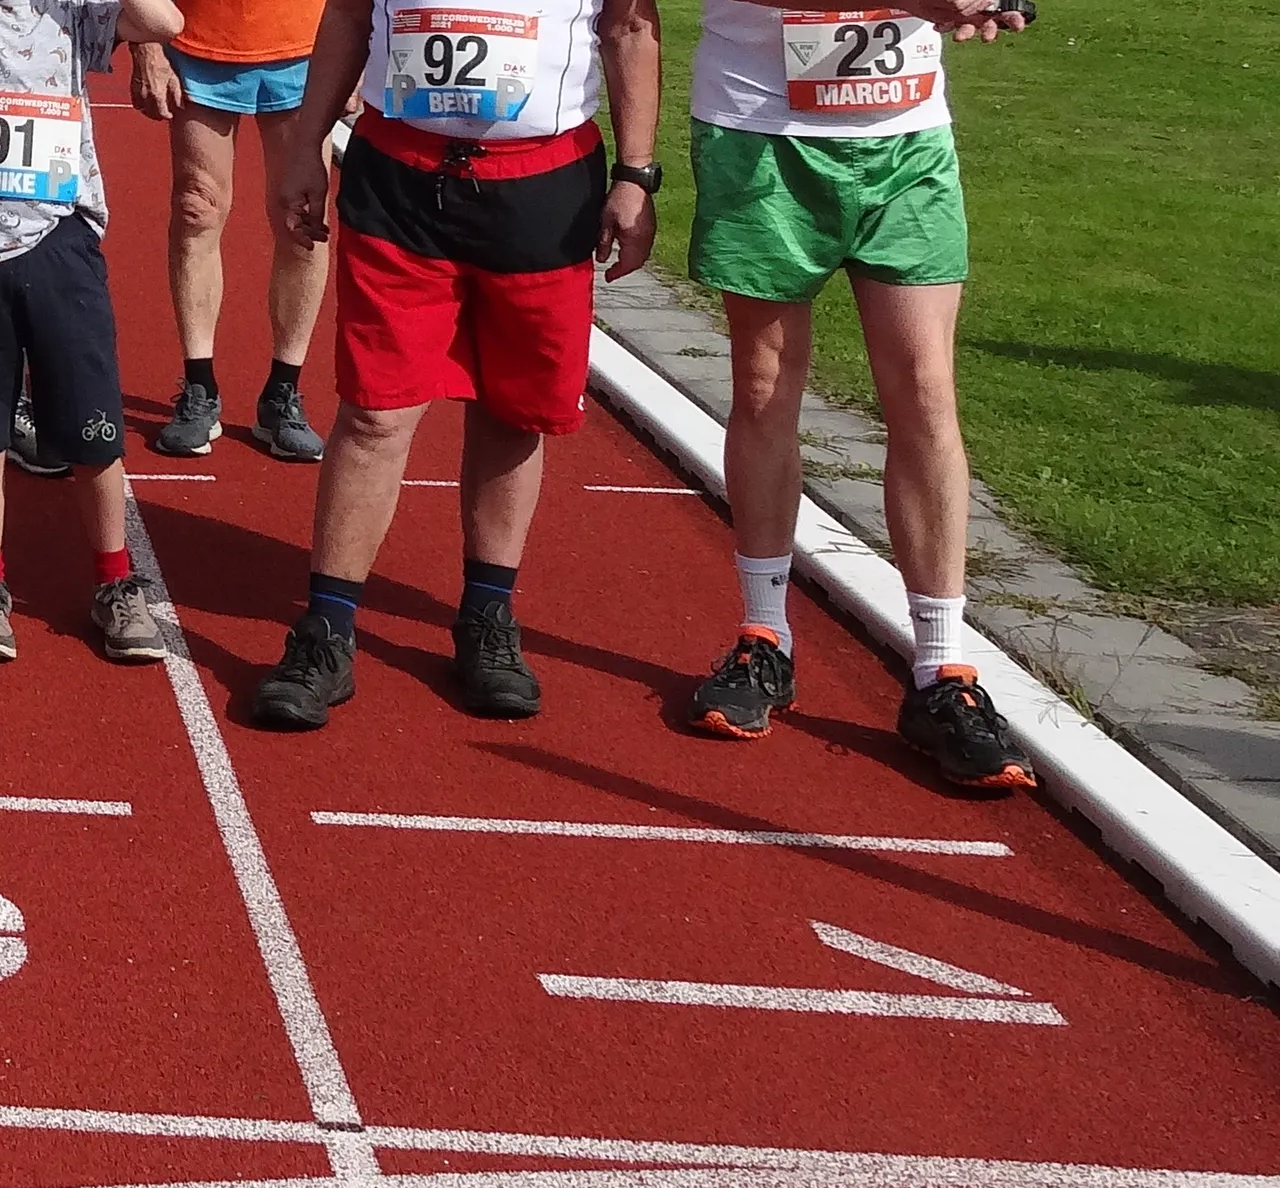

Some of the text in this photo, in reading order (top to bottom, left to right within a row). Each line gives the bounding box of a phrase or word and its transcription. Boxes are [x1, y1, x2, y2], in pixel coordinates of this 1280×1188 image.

[838, 11, 864, 20] 2021
[424, 34, 488, 87] 92
[834, 21, 905, 77] 23
[392, 74, 416, 114] P
[429, 92, 482, 114] BERT
[497, 78, 526, 117] P
[815, 78, 920, 106] MARCO T.
[47, 159, 72, 198] P
[537, 919, 1070, 1026] 1
